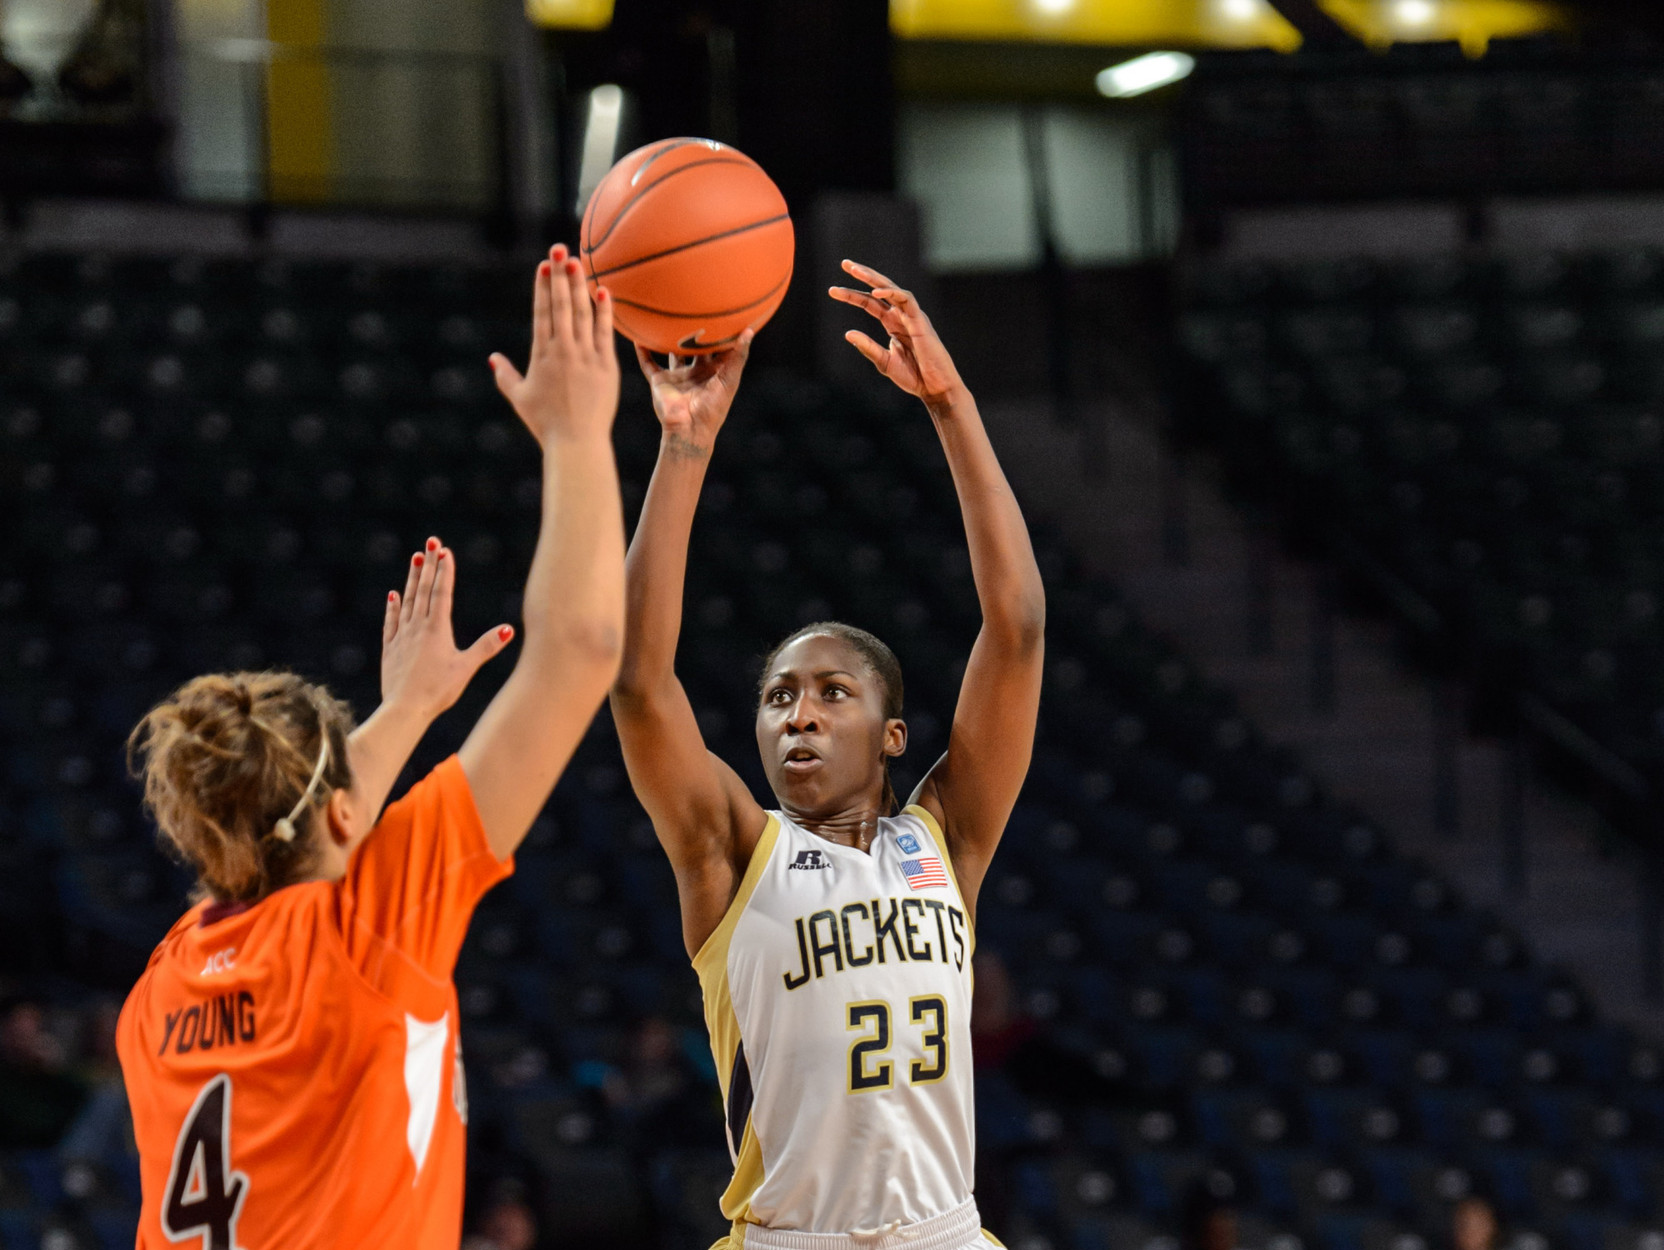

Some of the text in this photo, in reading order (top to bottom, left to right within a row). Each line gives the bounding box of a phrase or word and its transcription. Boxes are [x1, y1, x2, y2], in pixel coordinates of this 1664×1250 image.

[200, 947, 236, 976] ACC
[783, 897, 966, 991] JACKETS
[158, 988, 256, 1056] YOUNG
[846, 993, 950, 1095] 23
